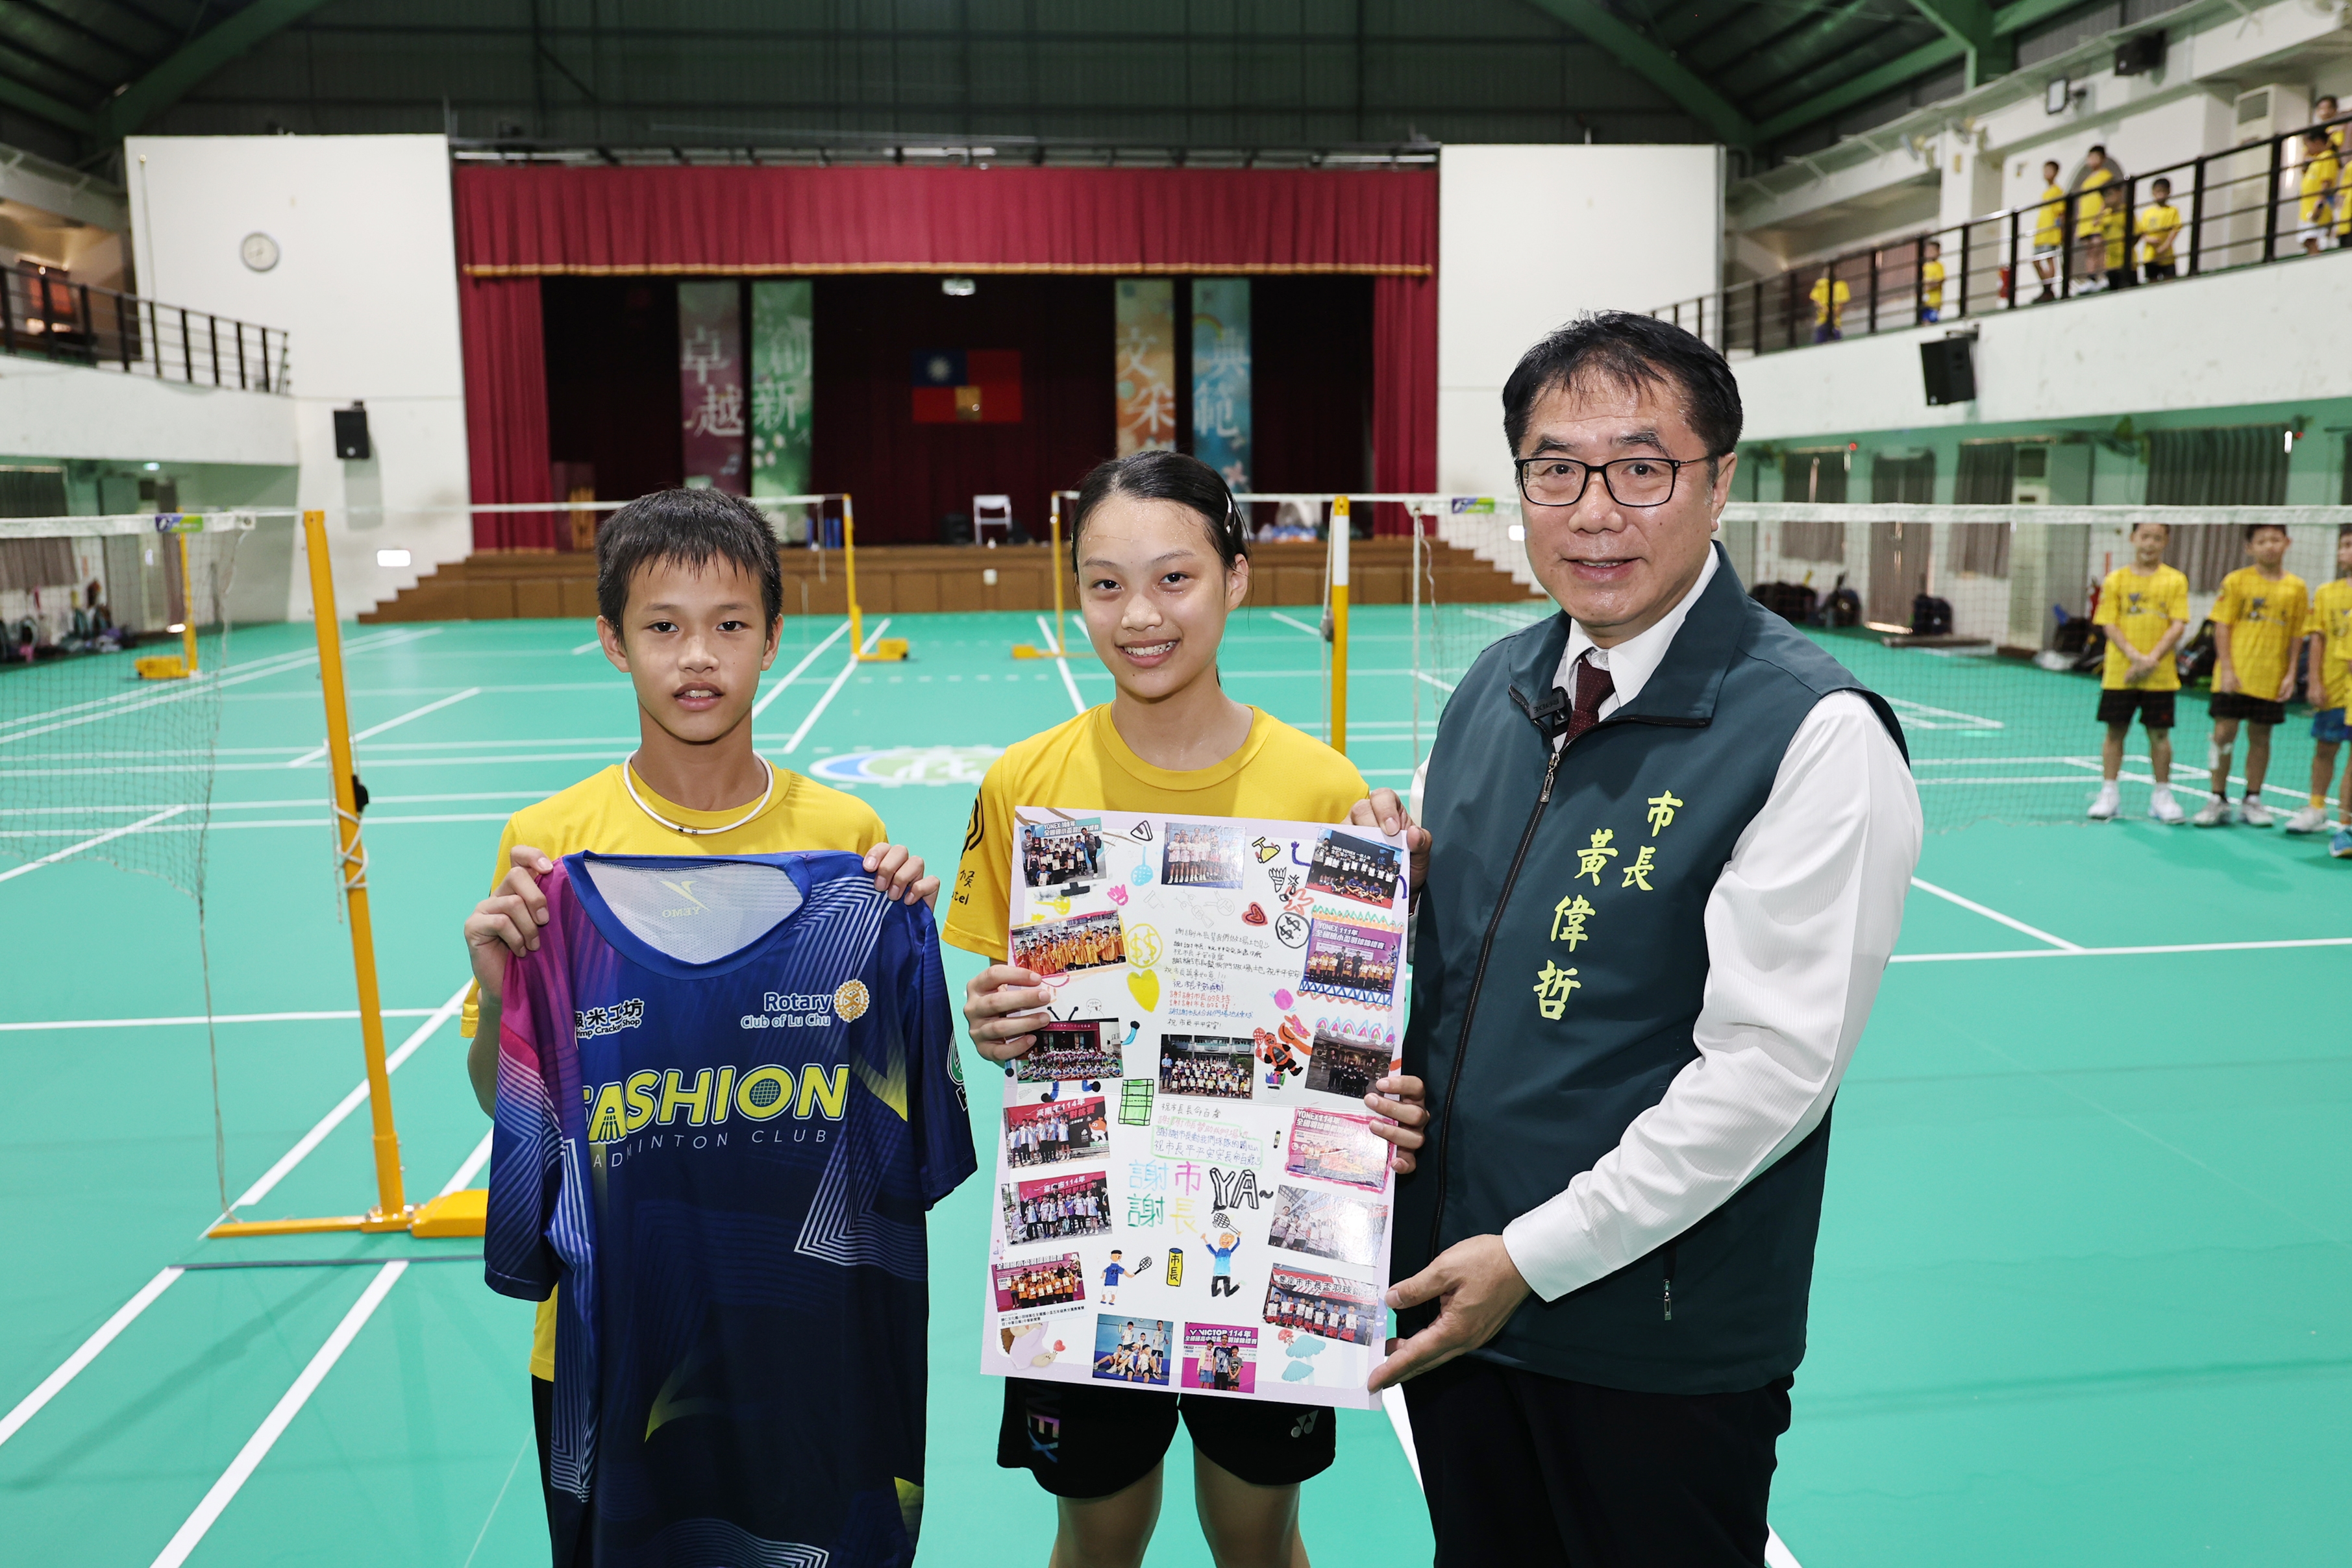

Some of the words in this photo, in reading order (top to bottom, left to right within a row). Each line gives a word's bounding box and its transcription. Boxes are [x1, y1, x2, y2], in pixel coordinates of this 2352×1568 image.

[682, 326, 745, 437] 卓越
[1621, 789, 1683, 891] 市長
[1319, 922, 1339, 933] YONEX
[1339, 927, 1359, 937] 111年
[1533, 827, 1618, 1021] 黃偉哲
[764, 992, 832, 1013] Rotary
[622, 1019, 640, 1027] Shop
[741, 1014, 770, 1029] Club
[771, 1014, 787, 1027] of
[788, 1014, 803, 1027] Lu
[806, 1012, 831, 1027] Chu
[583, 1063, 850, 1144] ASHION
[751, 1129, 826, 1144] CLUB
[1169, 1254, 1180, 1282] 市長
[1279, 1274, 1374, 1298] 臺南市市長盃羽球錦
[1229, 1330, 1252, 1338] 114年
